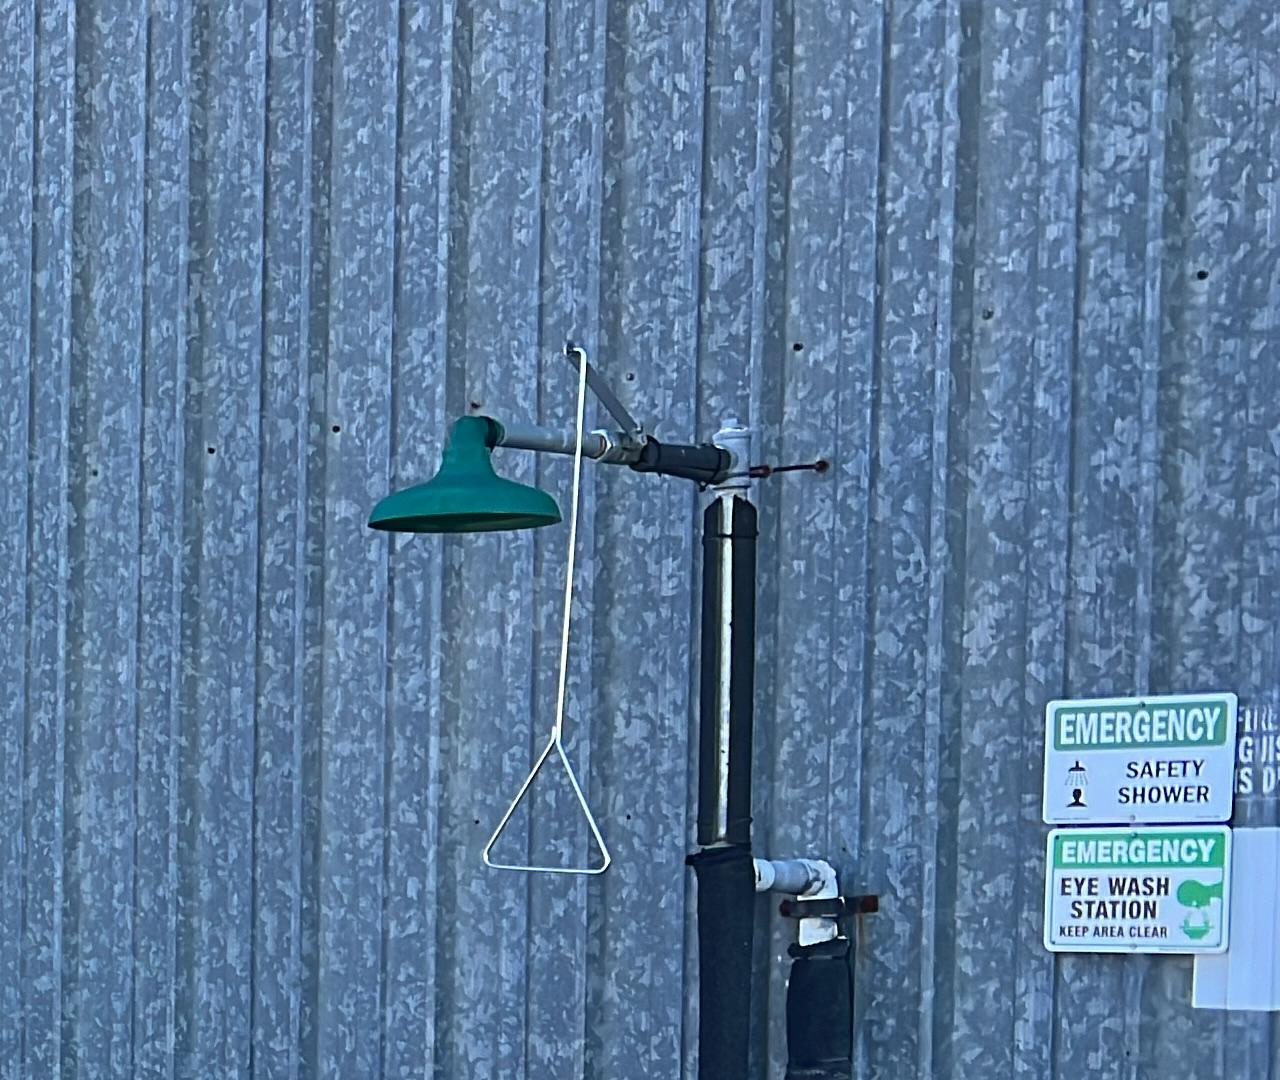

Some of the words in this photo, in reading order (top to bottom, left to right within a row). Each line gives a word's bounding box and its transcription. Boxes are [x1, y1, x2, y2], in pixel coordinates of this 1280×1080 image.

[1060, 707, 1222, 746] EMERGENCY
[1125, 760, 1205, 779] SAFETY
[1117, 786, 1211, 804] SHOWER
[1061, 838, 1217, 863] EMERGENCY
[1060, 877, 1099, 896] EYE
[1108, 877, 1170, 896] WASH
[1070, 900, 1157, 920] STATION
[1059, 926, 1090, 937] KEEP
[1093, 926, 1125, 937] AREA
[1129, 926, 1168, 938] CLEAR
